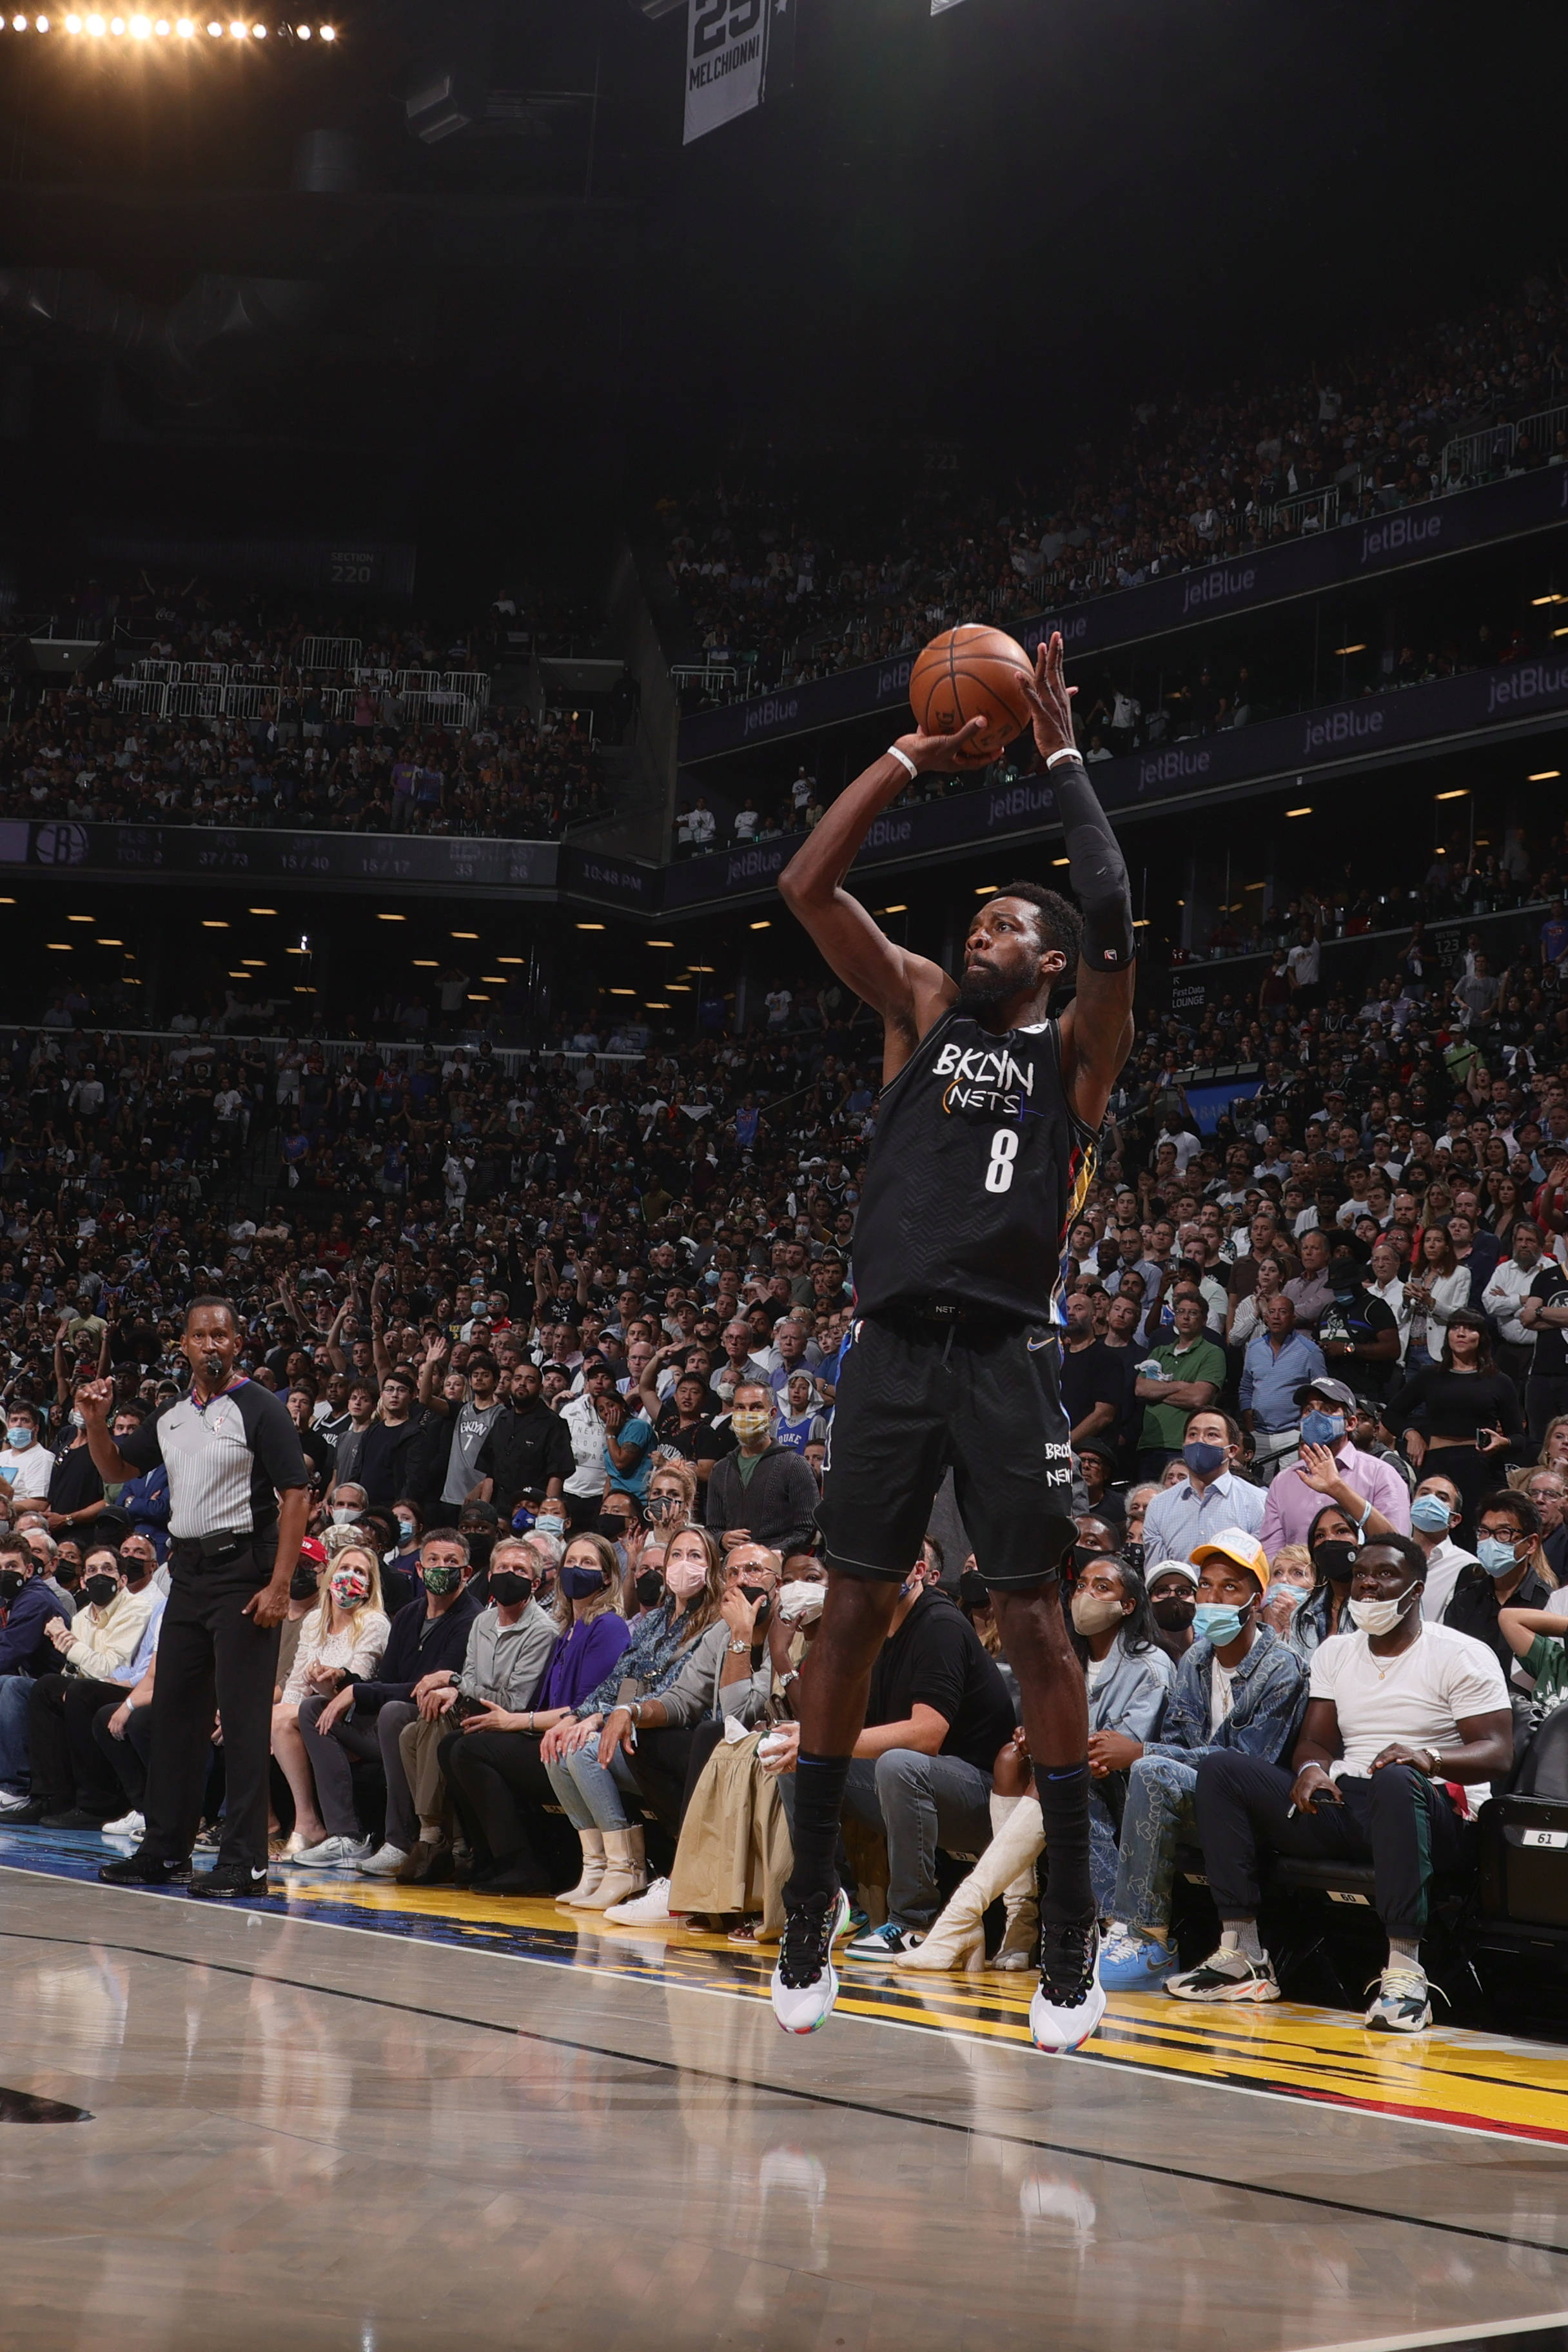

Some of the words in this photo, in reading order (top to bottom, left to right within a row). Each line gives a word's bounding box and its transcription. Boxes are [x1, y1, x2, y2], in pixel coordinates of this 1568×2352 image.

[693, 0, 760, 59] 25
[689, 35, 760, 92] MELCHIONNI
[1361, 515, 1441, 564] jetBlue
[330, 552, 374, 563] SECTION
[331, 565, 371, 583] 220
[1183, 569, 1255, 616] jetBlue
[877, 662, 912, 699] jetB
[744, 698, 798, 736] jetBlue
[1303, 710, 1384, 754] jetBlue
[1138, 750, 1210, 792] jetBlue
[987, 786, 1054, 827] jetBlue
[860, 819, 912, 850] tBlue
[727, 850, 782, 886] jetBlue
[1435, 939, 1460, 954] 123
[1172, 994, 1205, 1008] LOUNGE
[932, 1043, 1035, 1097] BKLYN
[985, 1129, 1019, 1193] 8
[936, 1306, 960, 1314] NET
[460, 1420, 487, 1437] BKLYN
[464, 1435, 473, 1451] 7
[577, 1427, 604, 1435] NEVE
[778, 1433, 802, 1445] DUKE
[1537, 1833, 1552, 1844] 61
[1340, 1893, 1357, 1902] 60
